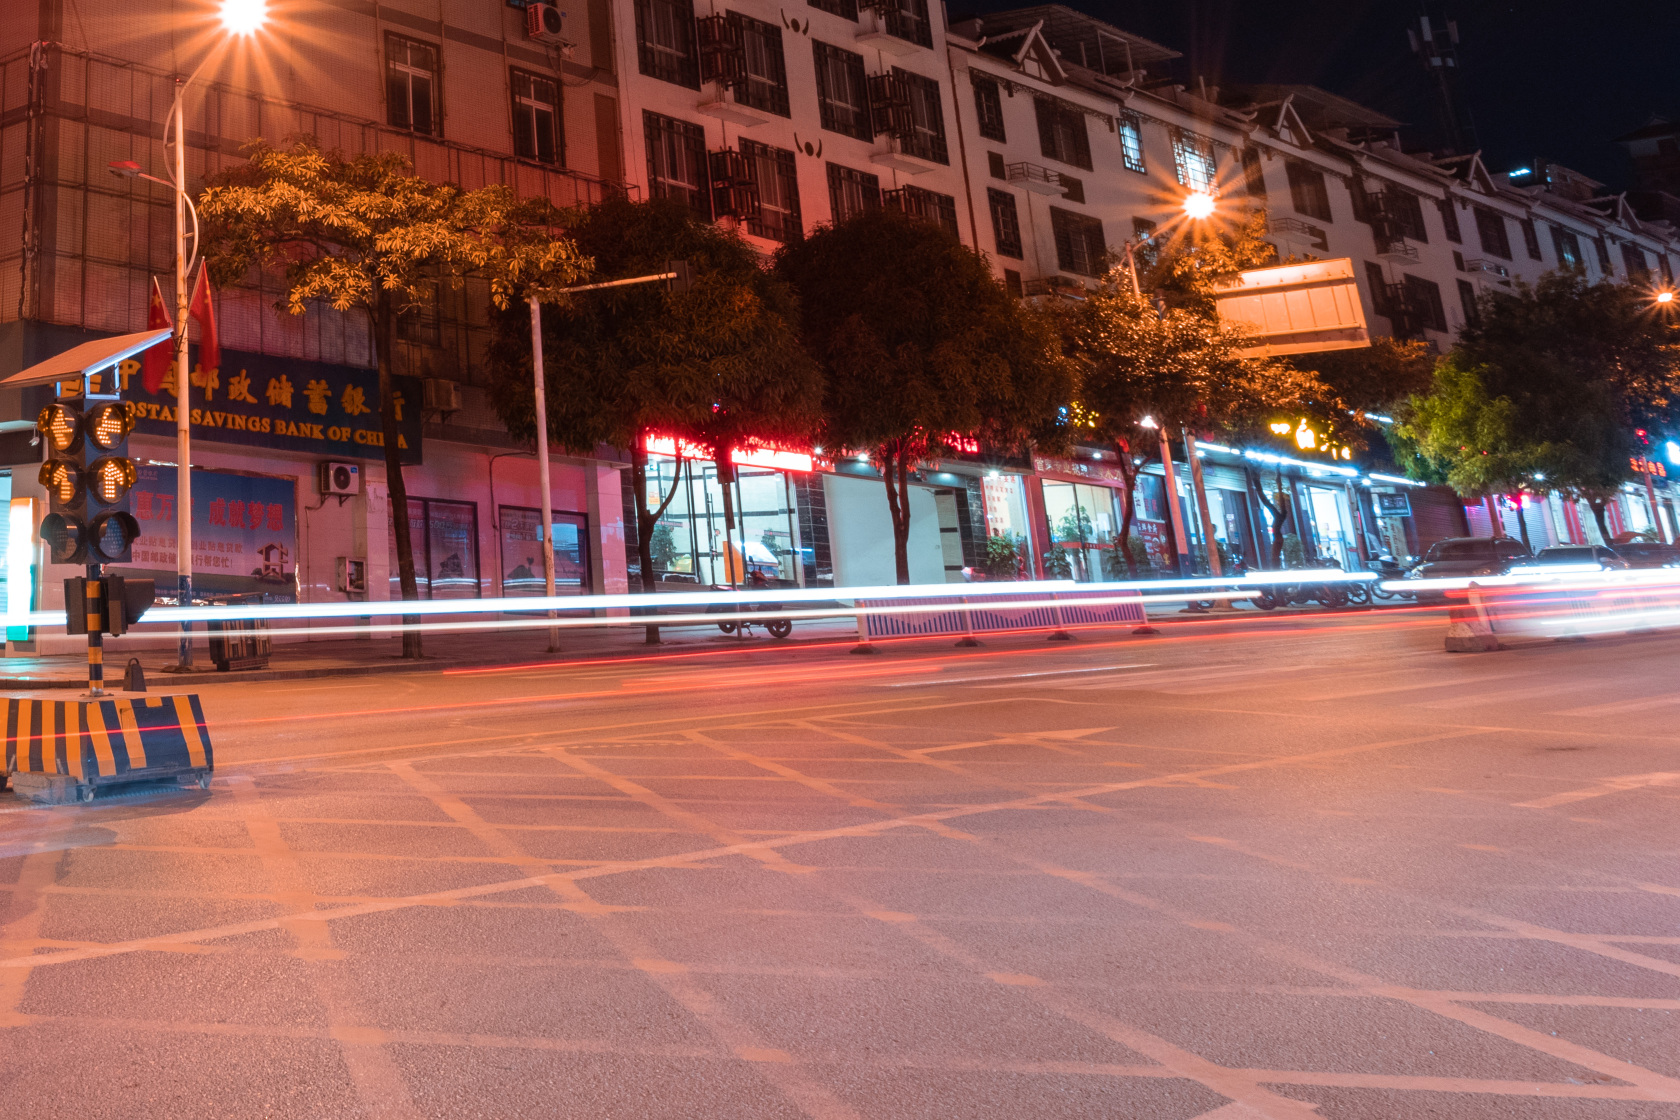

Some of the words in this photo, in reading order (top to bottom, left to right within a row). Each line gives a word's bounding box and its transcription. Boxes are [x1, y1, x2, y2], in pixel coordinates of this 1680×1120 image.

[189, 408, 271, 433] SAVINGS
[274, 419, 325, 440] BANK
[327, 426, 351, 442] OF
[353, 429, 409, 449] CHIA
[209, 497, 284, 531] 成就梦想
